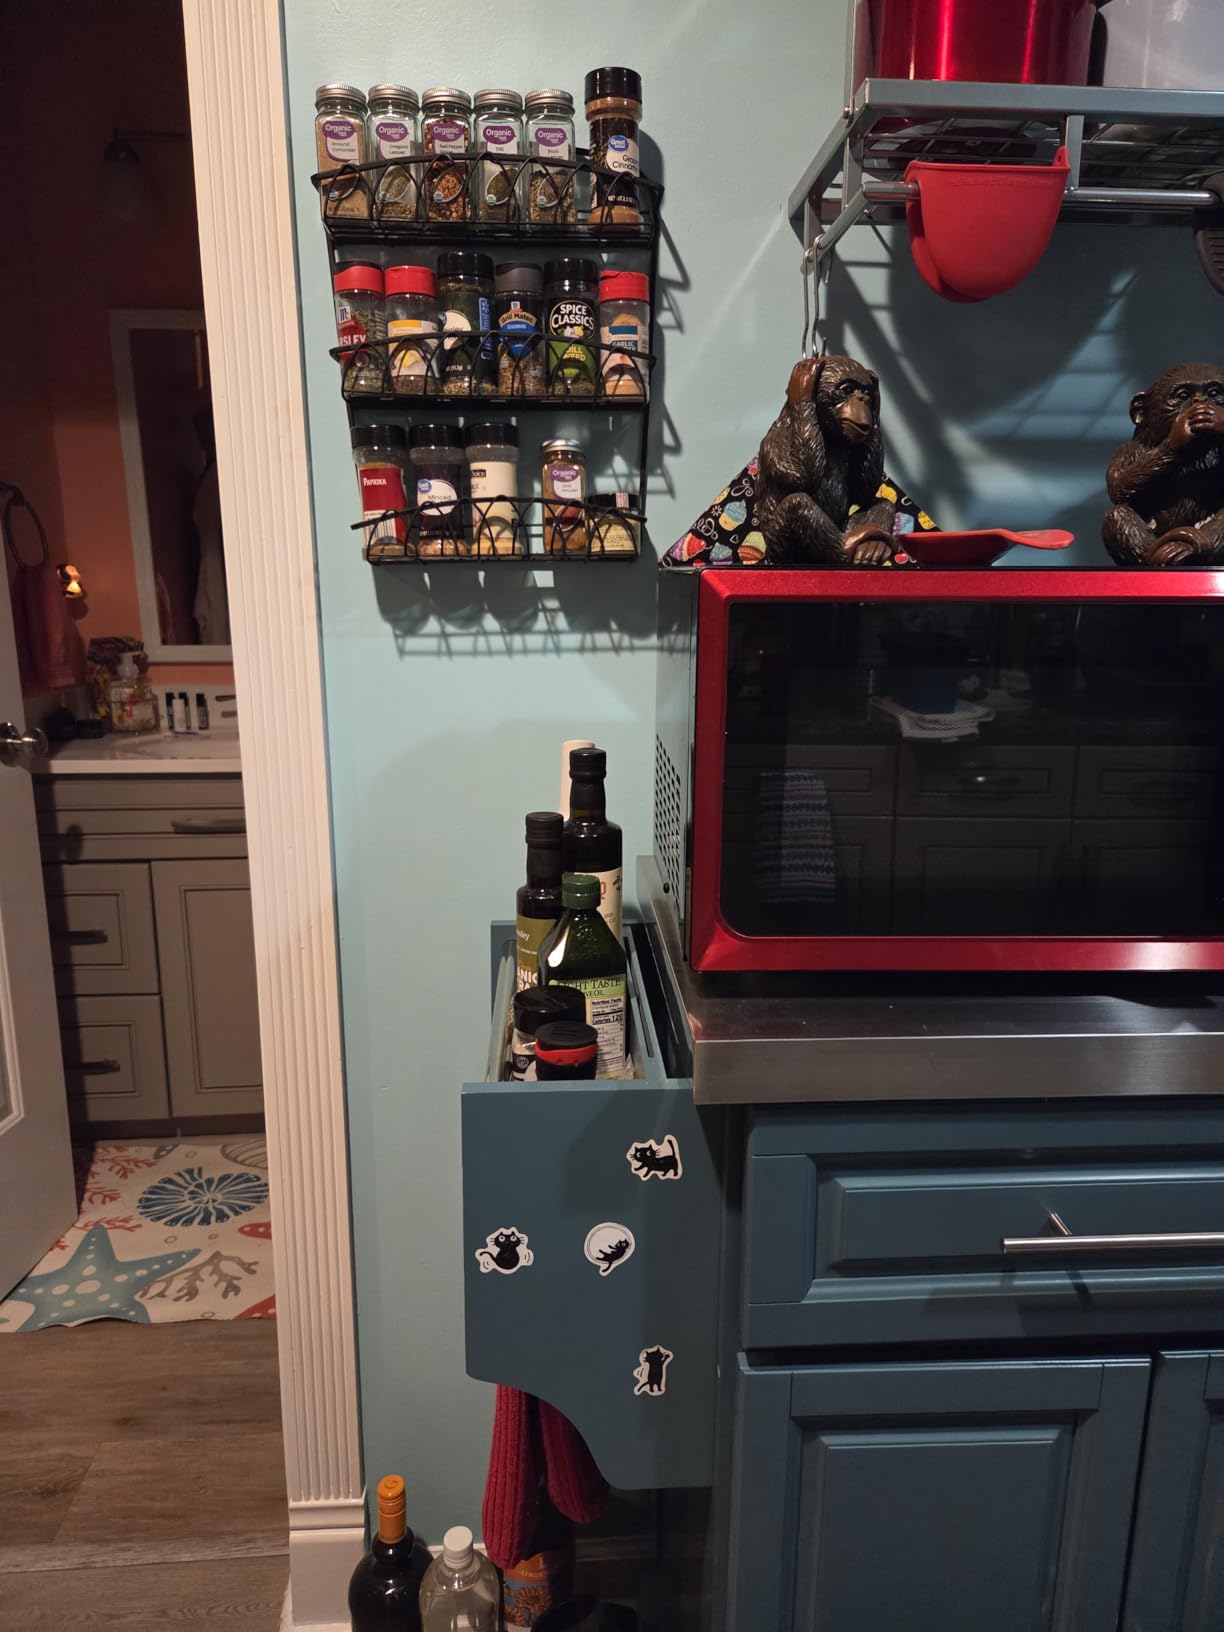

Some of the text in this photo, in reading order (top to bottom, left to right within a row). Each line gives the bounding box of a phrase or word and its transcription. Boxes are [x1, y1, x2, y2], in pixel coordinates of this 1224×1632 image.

[325, 124, 352, 134] Organic
[379, 126, 405, 136] Organic
[433, 127, 459, 136] Organic
[486, 129, 512, 138] Organic
[538, 131, 564, 140] Organic
[560, 304, 587, 315] SPICE
[551, 314, 594, 330] CLASSICS
[552, 469, 577, 478] Organic
[592, 977, 622, 990] TASTE
